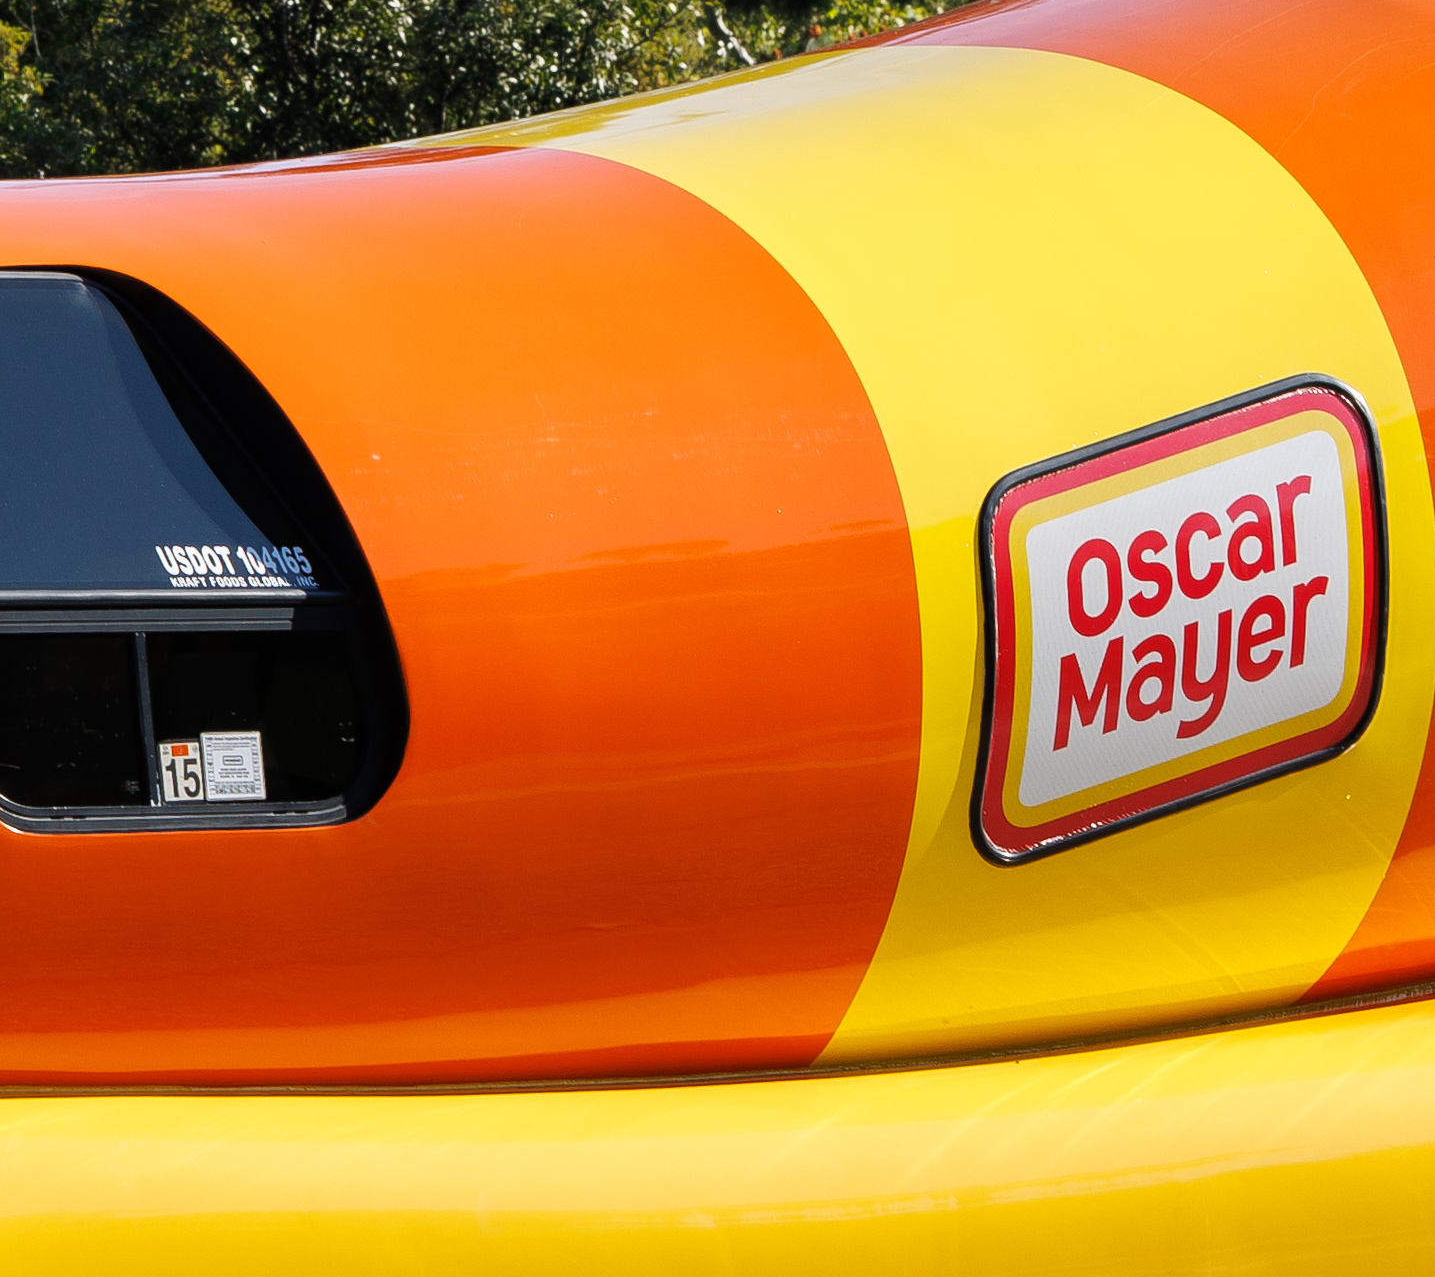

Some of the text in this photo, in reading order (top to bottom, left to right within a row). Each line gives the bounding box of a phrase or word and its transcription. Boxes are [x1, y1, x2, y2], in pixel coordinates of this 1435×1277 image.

[155, 545, 312, 576] USDOT 104165
[1067, 475, 1312, 637] Oscar
[169, 576, 208, 588] KRAFT
[208, 576, 248, 588] FOODS
[1053, 575, 1329, 753] Mayer
[165, 758, 201, 798] 15
